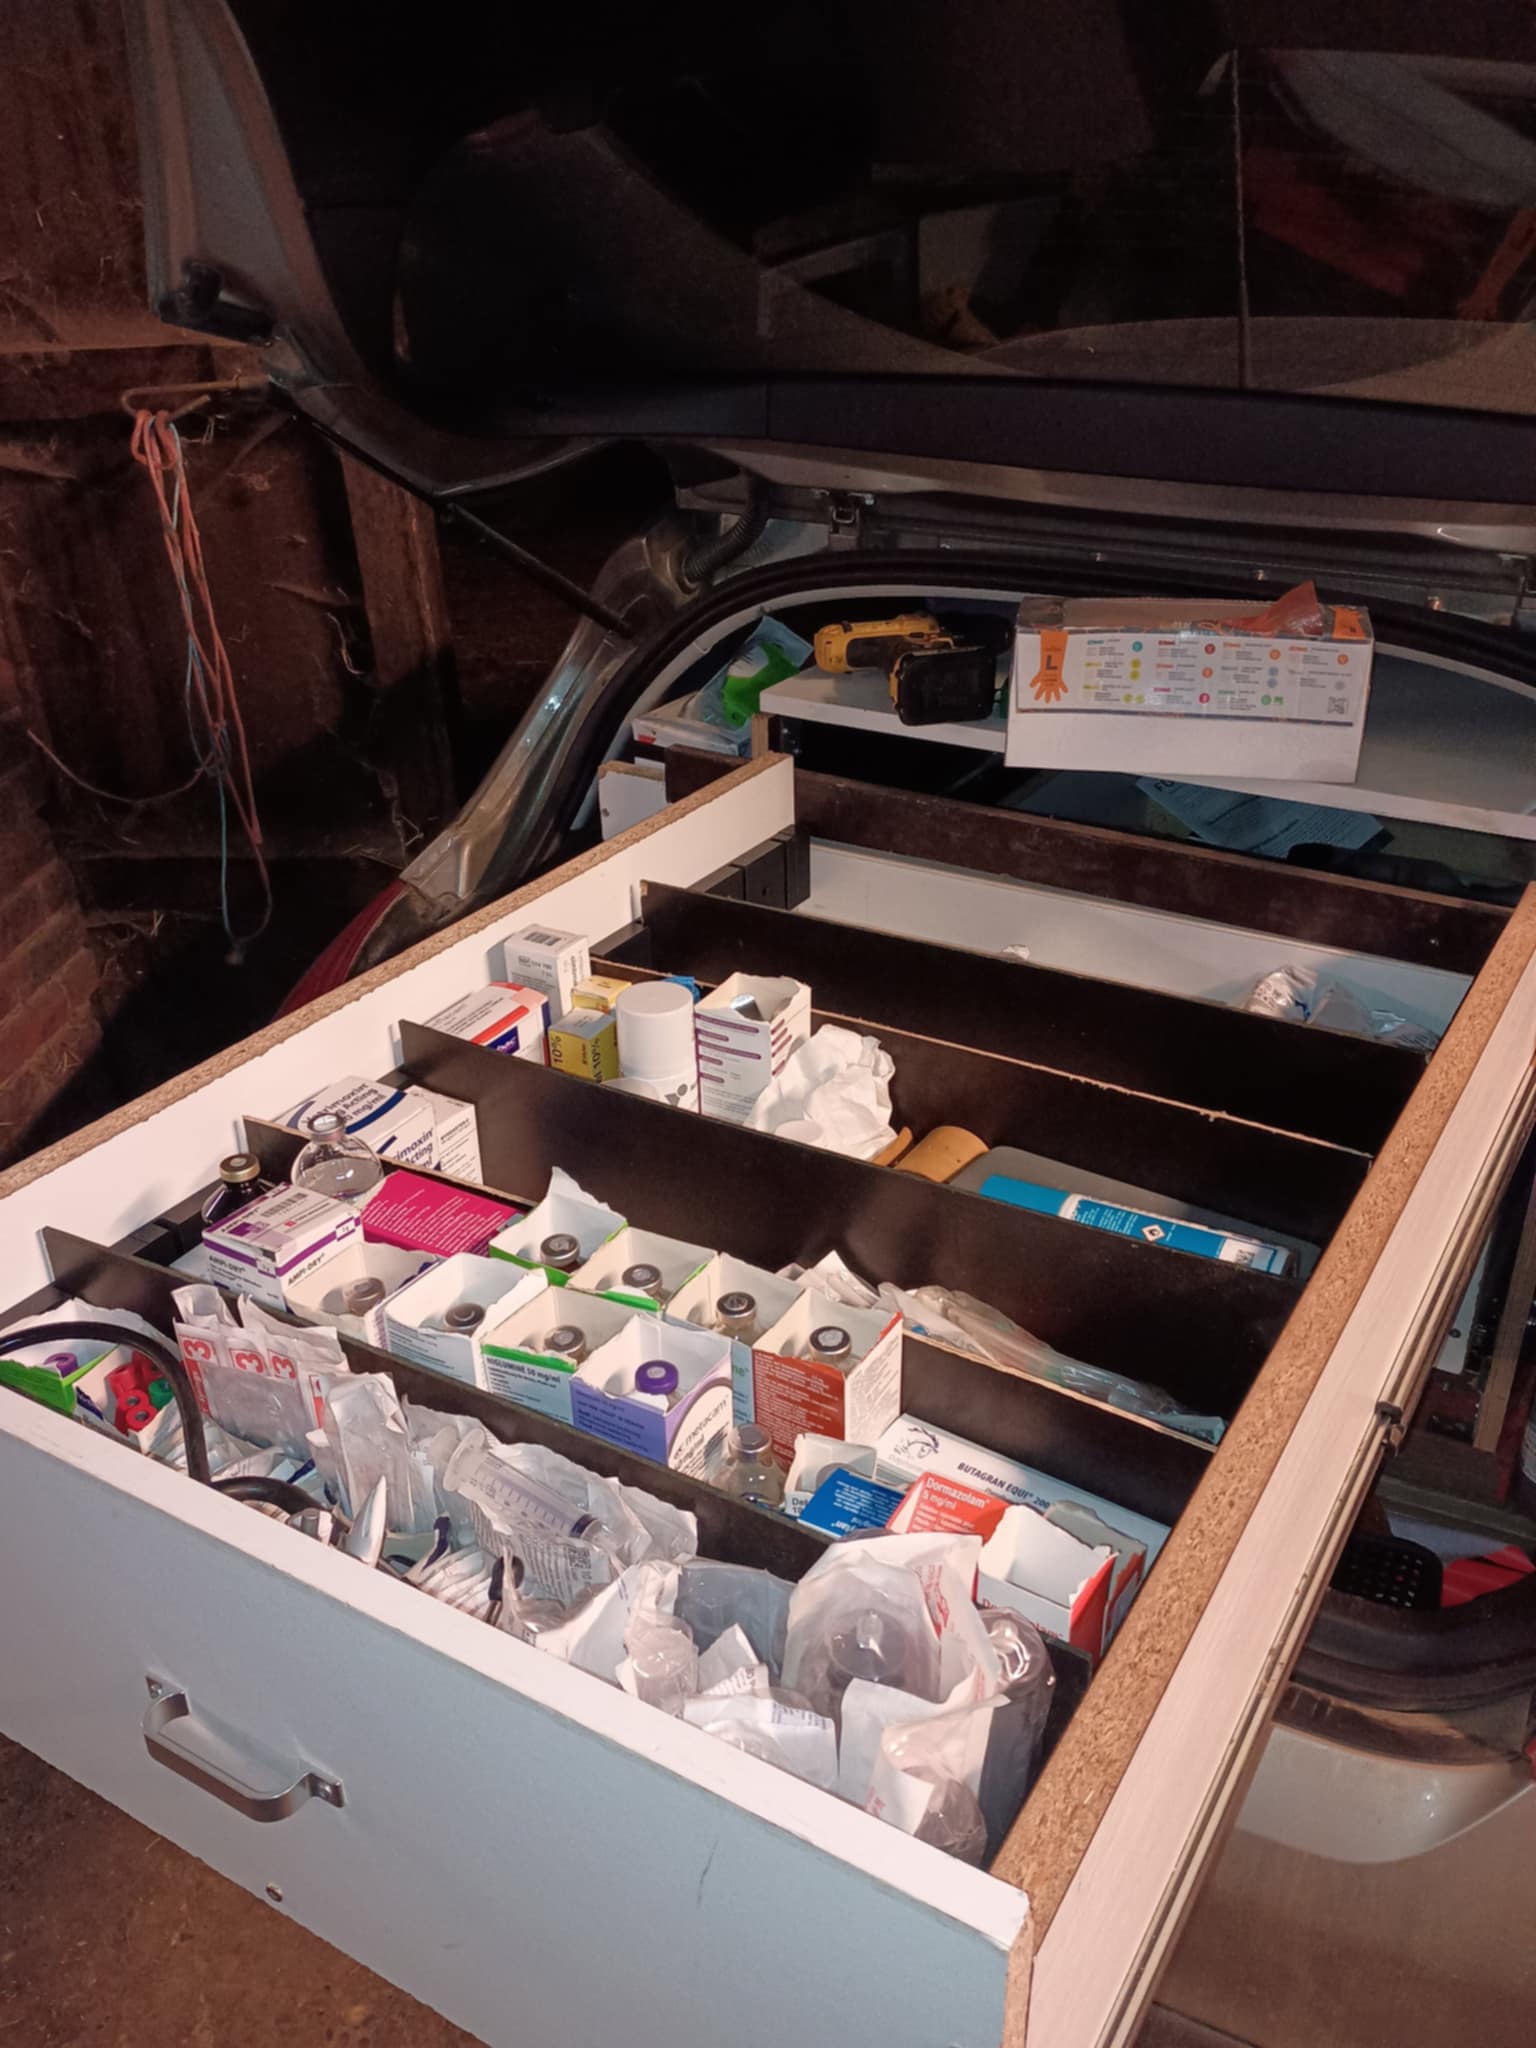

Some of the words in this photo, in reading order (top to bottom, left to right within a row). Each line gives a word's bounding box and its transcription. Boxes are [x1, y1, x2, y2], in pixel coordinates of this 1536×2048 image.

[1045, 655, 1058, 670] L
[551, 1036, 564, 1063] 10%
[183, 1339, 212, 1360] 3
[235, 1352, 264, 1374] 3
[271, 1355, 297, 1379] 3
[957, 1462, 1006, 1490] BUTAGRAN
[929, 1494, 957, 1511] mg/ml
